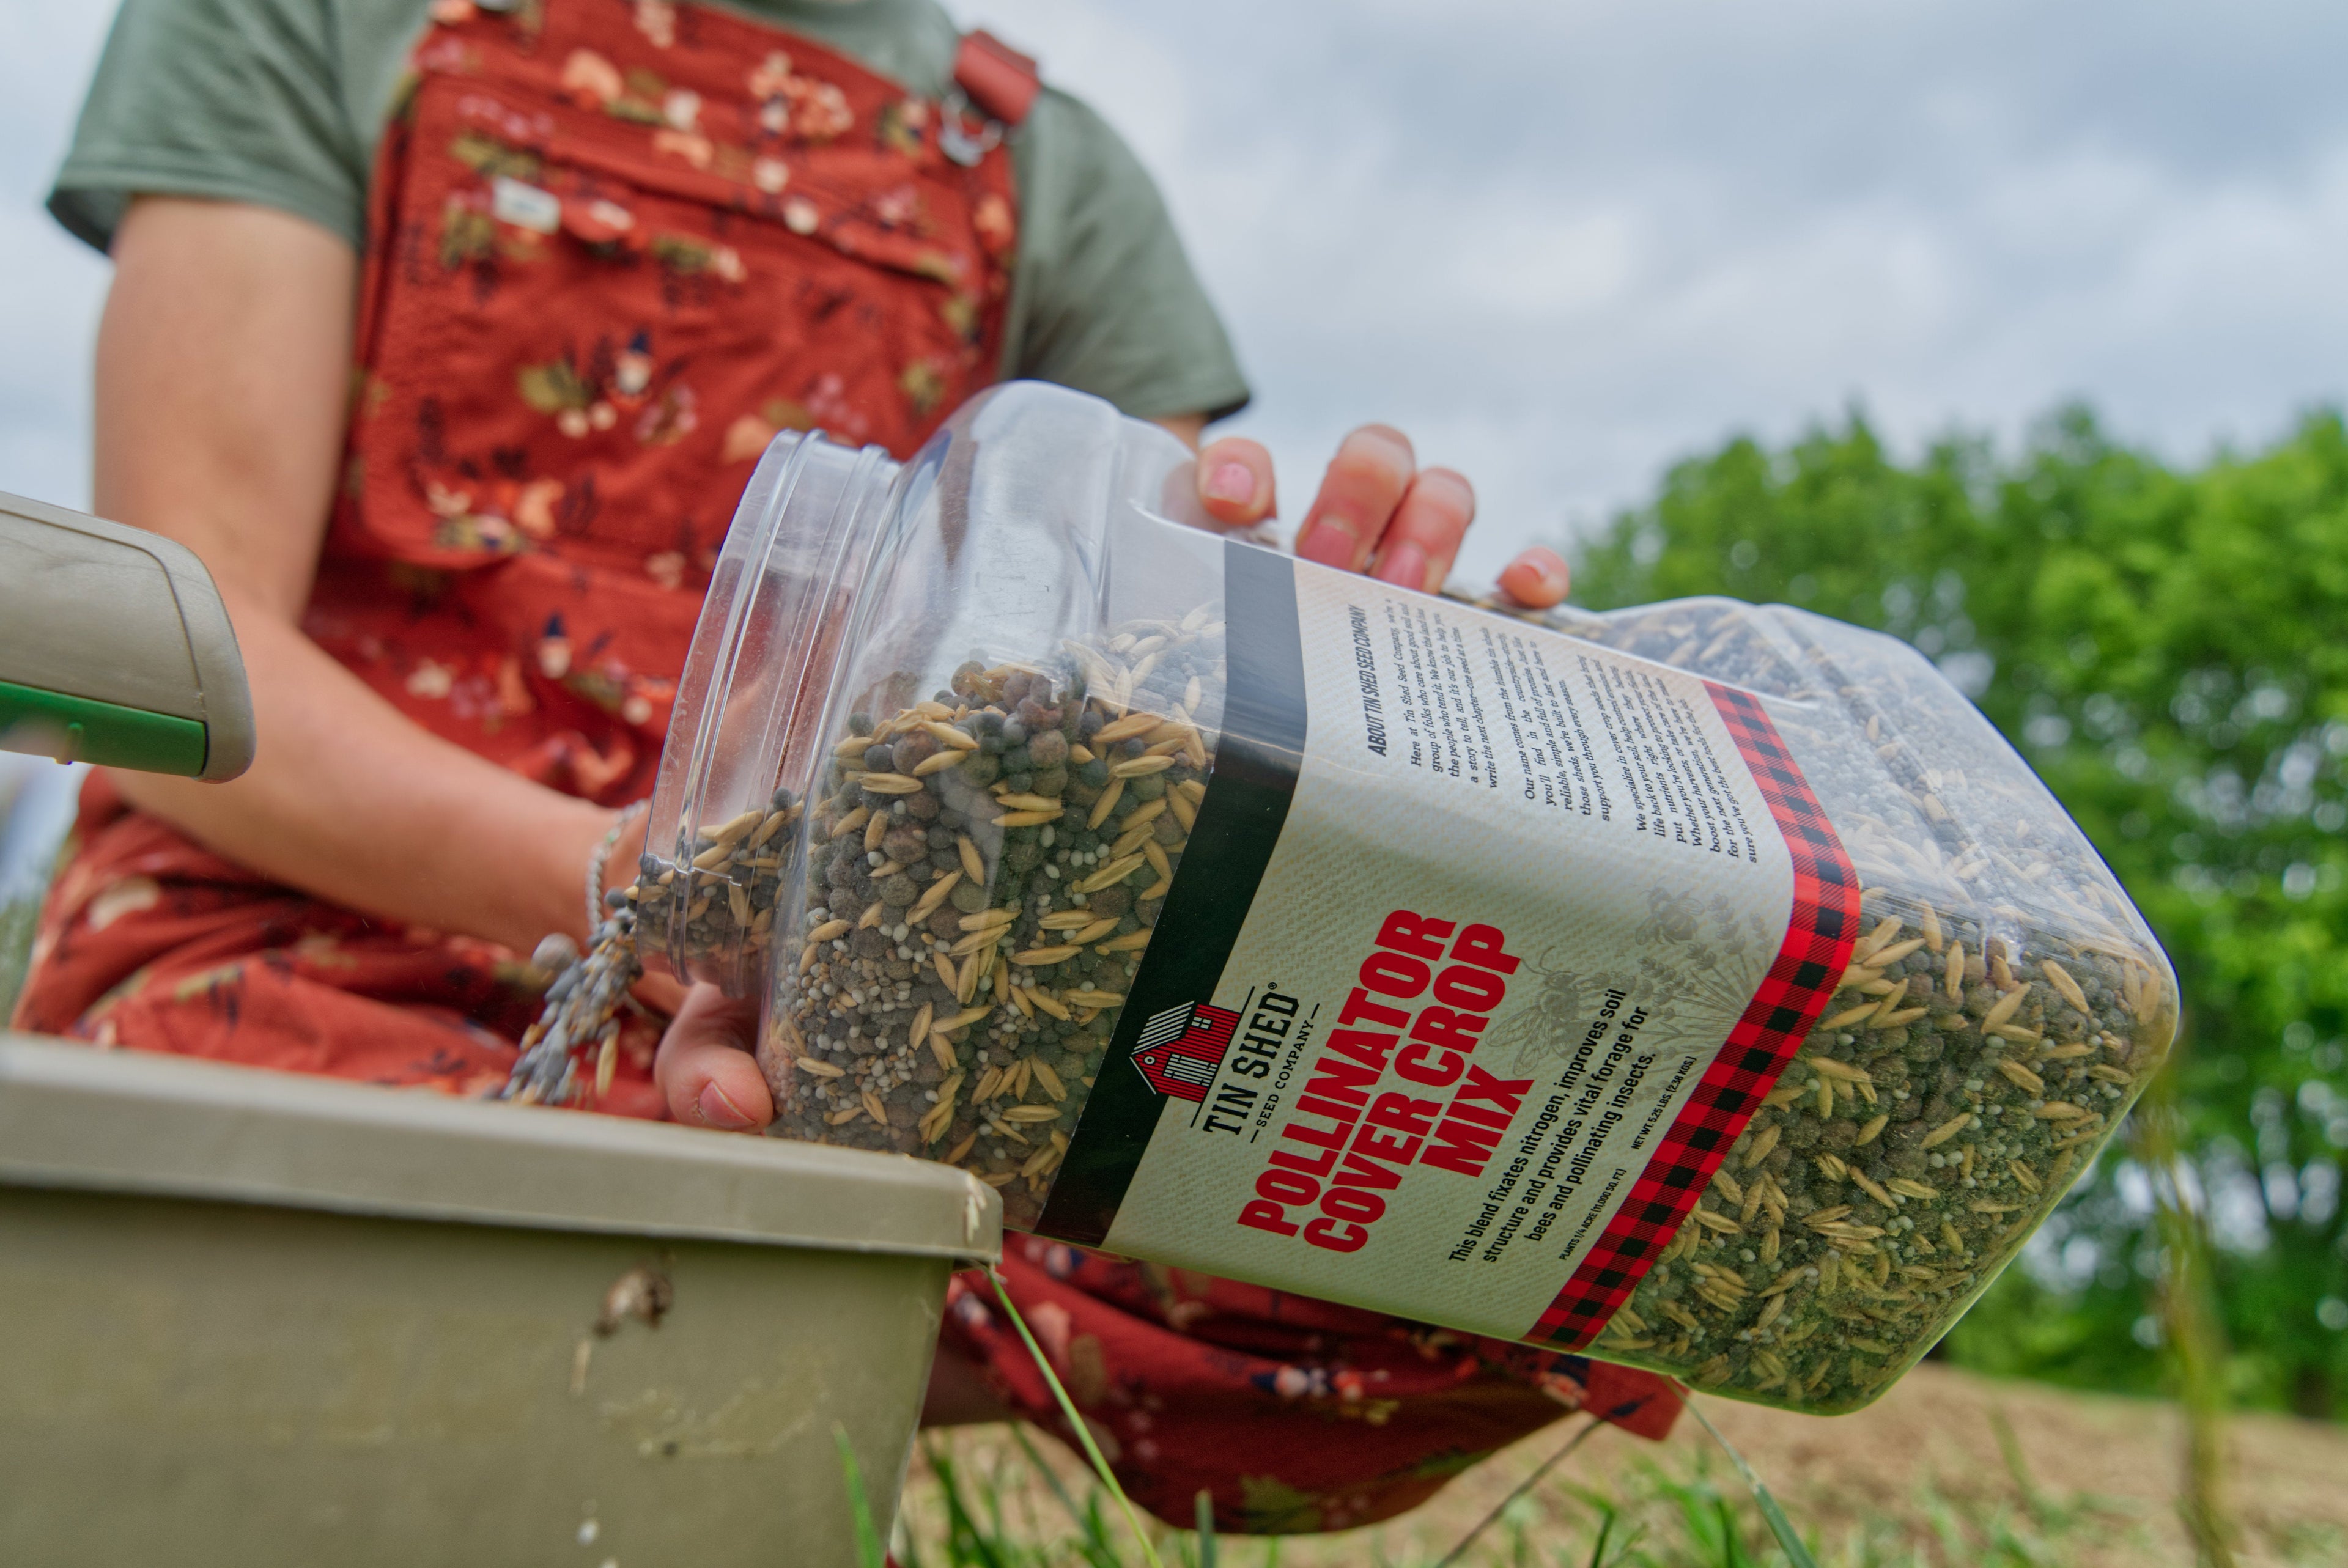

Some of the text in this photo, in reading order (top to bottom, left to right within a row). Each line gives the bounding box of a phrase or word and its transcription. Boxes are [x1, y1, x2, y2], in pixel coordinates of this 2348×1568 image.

[1348, 604, 1387, 757] ABOUT TIN SHED SEED COMPANY
[1414, 671, 1426, 688] care
[1397, 683, 1413, 706] Shed
[1416, 688, 1430, 706] who
[1431, 689, 1447, 710] tend
[1450, 696, 1465, 713] and
[1402, 709, 1416, 723] Tin
[1420, 707, 1434, 728] folks
[1438, 709, 1452, 727] who
[1503, 701, 1516, 721] from
[1520, 709, 1534, 723] the
[1533, 706, 1549, 722] full
[1551, 709, 1567, 728] built
[1567, 705, 1582, 728] every
[1407, 726, 1419, 737] at
[1422, 727, 1437, 740] of
[1455, 716, 1470, 732] tell,
[1475, 724, 1490, 744] next
[1509, 721, 1525, 749] comes
[1526, 730, 1539, 740] in
[1538, 721, 1554, 738] and
[1619, 726, 1635, 744] help
[1441, 727, 1461, 758] people
[1462, 734, 1473, 743] to
[1573, 728, 1595, 761] through
[1608, 730, 1623, 754] cover
[1409, 740, 1422, 767] Here
[1430, 740, 1444, 773] group
[1465, 745, 1479, 771] story
[1480, 744, 1494, 760] the
[1518, 749, 1532, 776] name
[1530, 746, 1547, 766] find
[1545, 738, 1563, 768] simple
[1615, 754, 1628, 765] in
[1625, 745, 1642, 762] soil,
[1642, 744, 1659, 766] right
[1657, 742, 1678, 774] looking
[1674, 746, 1685, 757] or
[1447, 758, 1460, 778] the
[1483, 760, 1497, 789] write
[1567, 755, 1585, 783] sheds,
[1587, 762, 1604, 780] you
[1635, 761, 1653, 784] your
[1691, 749, 1720, 795] generation,
[1706, 756, 1722, 774] best
[1469, 775, 1479, 784] a
[1523, 776, 1535, 800] Our
[1621, 765, 1645, 811] specialize
[1644, 782, 1655, 793] to
[1680, 759, 1703, 797] harvests,
[1716, 774, 1730, 789] the
[1556, 770, 1573, 811] reliable,
[1579, 785, 1592, 816] those
[1592, 779, 1612, 822] support
[1655, 771, 1678, 814] nutrients
[1722, 789, 1740, 806] got
[1645, 793, 1663, 816] back
[1696, 797, 1716, 821] your
[1710, 796, 1727, 817] next
[1635, 812, 1647, 831] We
[1652, 817, 1666, 837] life
[1672, 821, 1688, 844] put
[1683, 801, 1703, 847] Whether
[1721, 819, 1735, 836] the
[1705, 821, 1721, 853] boost
[1726, 838, 1740, 858] for
[1744, 836, 1757, 864] sure
[1236, 909, 1456, 1237] POLLINATOR
[1255, 1020, 1313, 1127] SEED COMPANY
[1303, 923, 1521, 1253] COVER CROP
[1202, 1083, 1258, 1135] TIN
[1419, 1063, 1534, 1177] MIX
[1448, 988, 1626, 1261] This blend fixates nitrogen, improves soil
[1631, 1135, 1645, 1149] NET
[1639, 1123, 1653, 1135] WT.
[1647, 1108, 1663, 1122] 5.25
[1656, 1094, 1672, 1108] LBS.
[1483, 1006, 1648, 1262] structure and provides vital forage for
[1523, 1053, 1656, 1241] bees and pollinating insects.
[1558, 1238, 1579, 1260] PLANTS
[1573, 1229, 1586, 1238] 1/4
[1581, 1212, 1597, 1229] ACRE
[1605, 1182, 1618, 1191] SQ.
